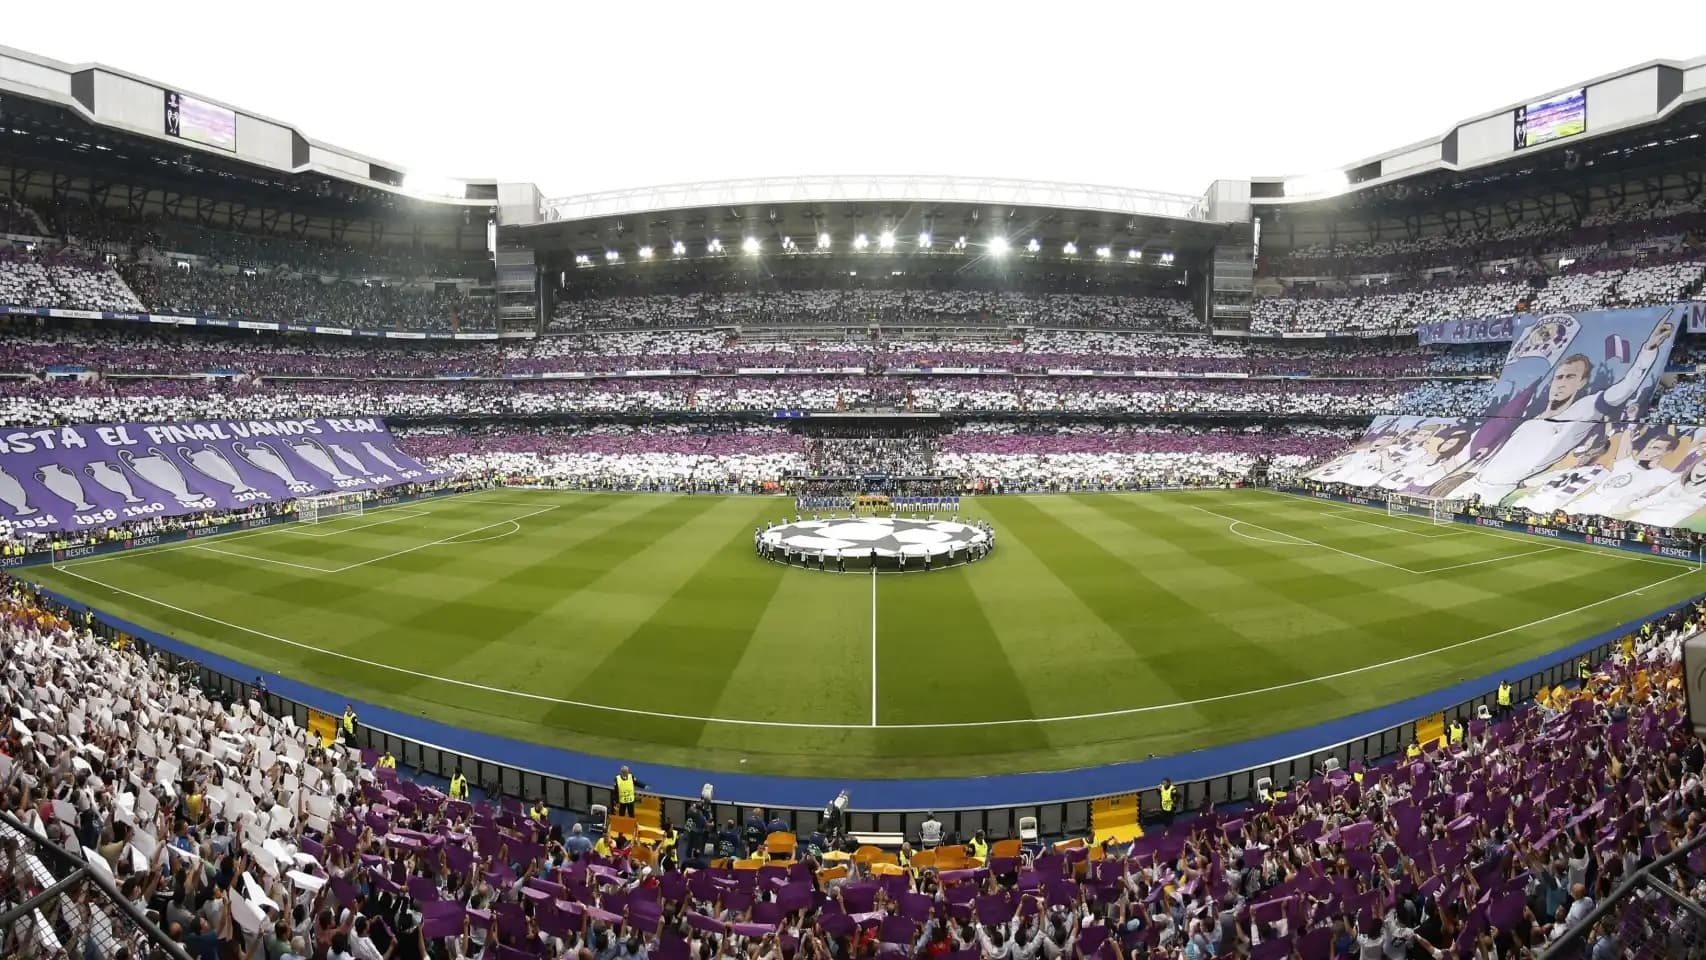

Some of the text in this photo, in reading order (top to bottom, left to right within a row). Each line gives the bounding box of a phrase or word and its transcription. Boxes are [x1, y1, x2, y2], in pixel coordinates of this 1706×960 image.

[1452, 317, 1513, 339] ATACA
[95, 425, 138, 446] EL
[228, 418, 322, 438] VAMOS
[325, 418, 384, 433] REAL
[123, 502, 165, 517] 1960
[72, 508, 117, 525] 1958
[249, 517, 271, 527] RESPECT
[1482, 518, 1504, 528] RESPECT
[194, 526, 219, 536] RESPECT
[1534, 527, 1559, 537] RESPECT
[133, 535, 160, 547] RESPECT
[1593, 536, 1621, 547] RESPECT
[66, 546, 96, 558] RESPECT
[1661, 546, 1692, 558] RESPECT
